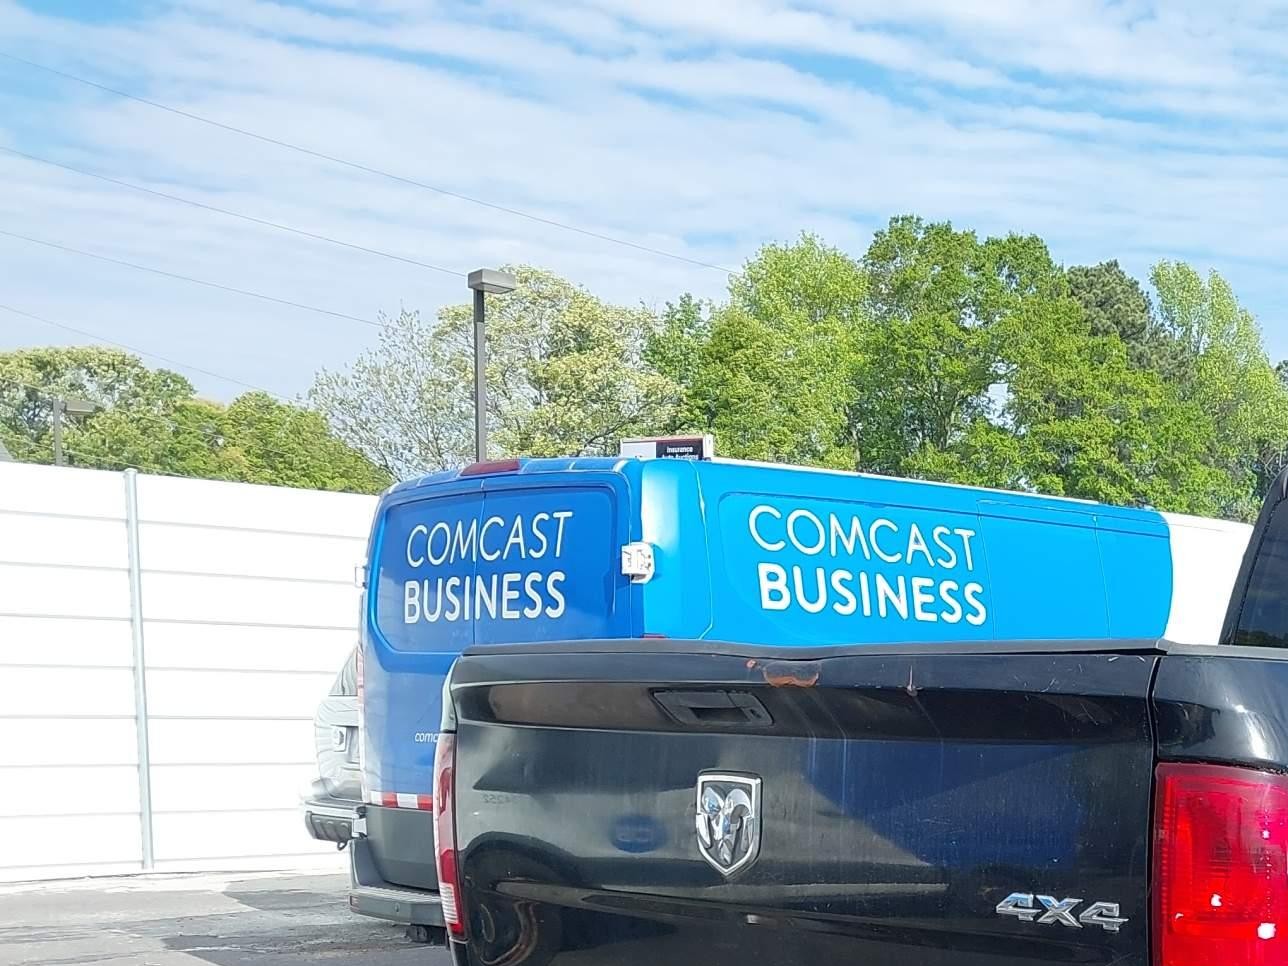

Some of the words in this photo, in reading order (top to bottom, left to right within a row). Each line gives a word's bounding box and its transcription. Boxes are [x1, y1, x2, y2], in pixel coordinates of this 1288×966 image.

[406, 510, 574, 568] COMCAST
[748, 504, 976, 571] COMCAST
[404, 571, 566, 624] BUSINESS
[757, 562, 987, 626] BUSINESS
